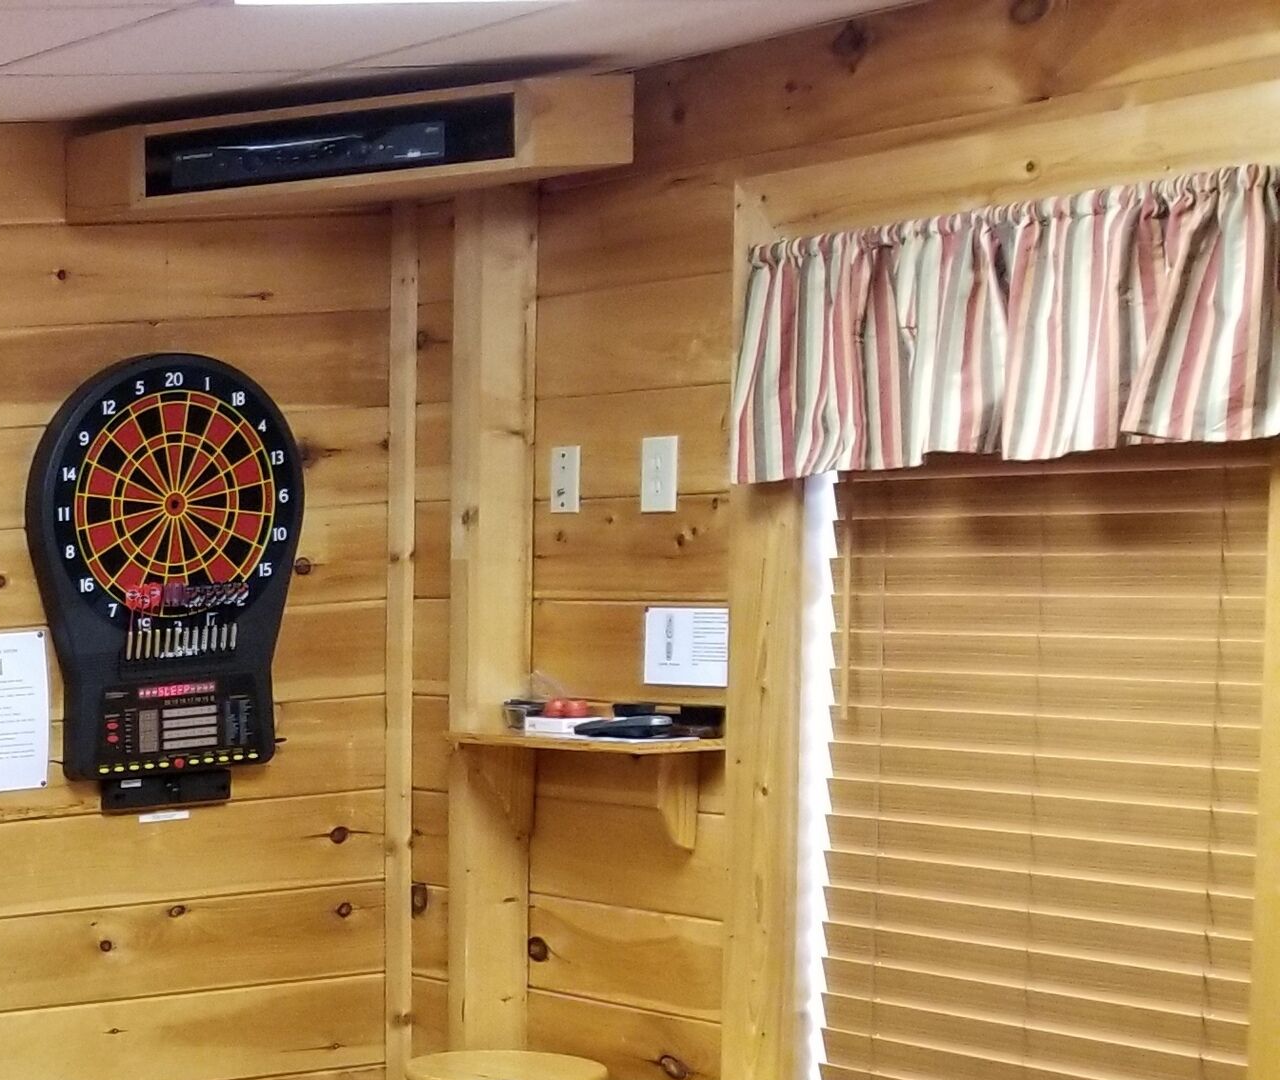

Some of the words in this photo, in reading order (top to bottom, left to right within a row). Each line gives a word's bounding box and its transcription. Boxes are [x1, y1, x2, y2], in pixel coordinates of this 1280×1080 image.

[165, 372, 183, 387] 20
[204, 376, 211, 391] 1
[135, 381, 145, 395] 5
[231, 391, 246, 407] 18
[102, 401, 116, 415] 12
[257, 418, 267, 432] 4
[79, 431, 90, 446] 9
[271, 451, 285, 466] 13
[62, 466, 77, 482] 14
[279, 489, 289, 503] 6
[57, 506, 71, 522] 11
[272, 527, 287, 542] 10
[65, 546, 75, 559] 8
[259, 563, 272, 577] 15
[79, 578, 94, 592] 16
[108, 603, 118, 617] 7
[158, 684, 190, 697] SLEEP
